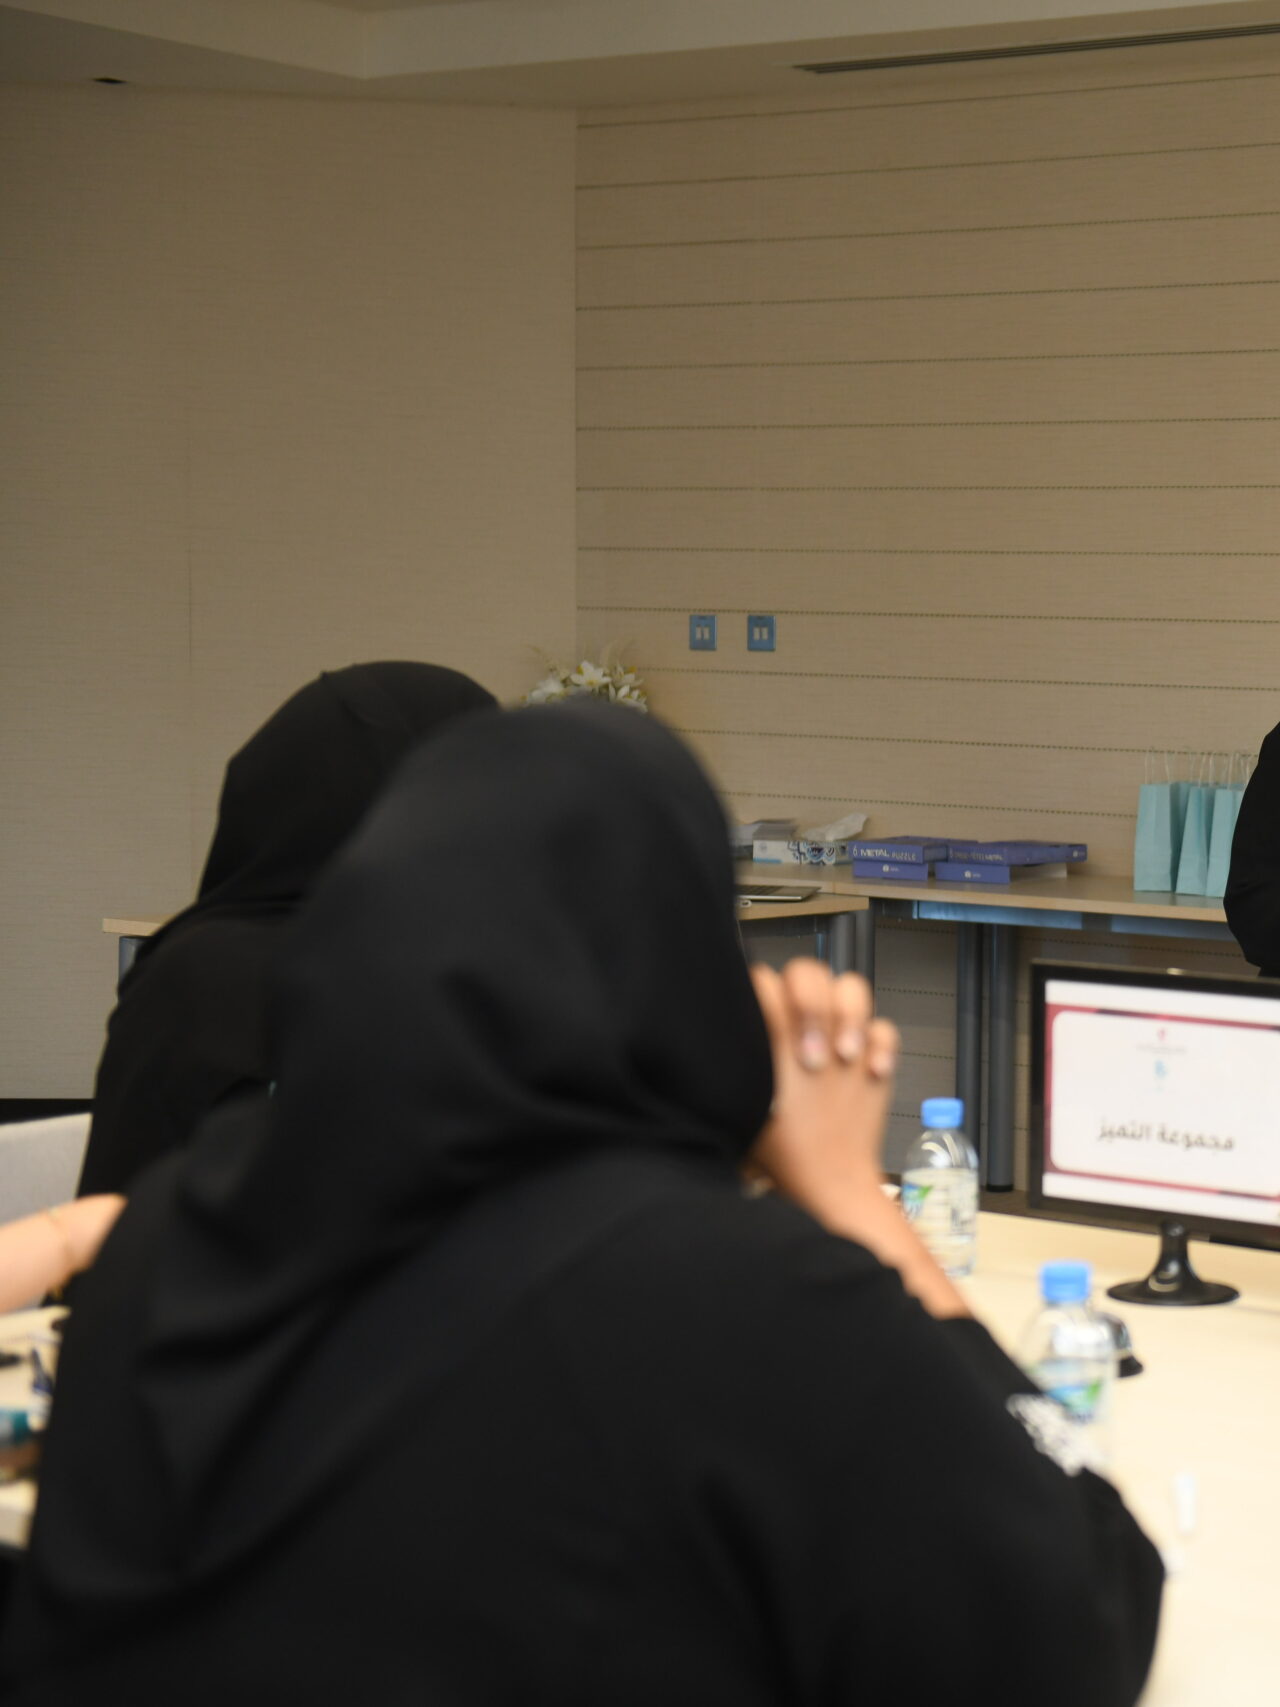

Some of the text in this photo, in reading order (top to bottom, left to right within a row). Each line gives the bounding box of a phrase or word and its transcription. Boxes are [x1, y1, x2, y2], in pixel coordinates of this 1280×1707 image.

[860, 847, 890, 857] METAL
[892, 850, 916, 861] PUZZLE
[1097, 1118, 1235, 1154] مجموعة التميز
